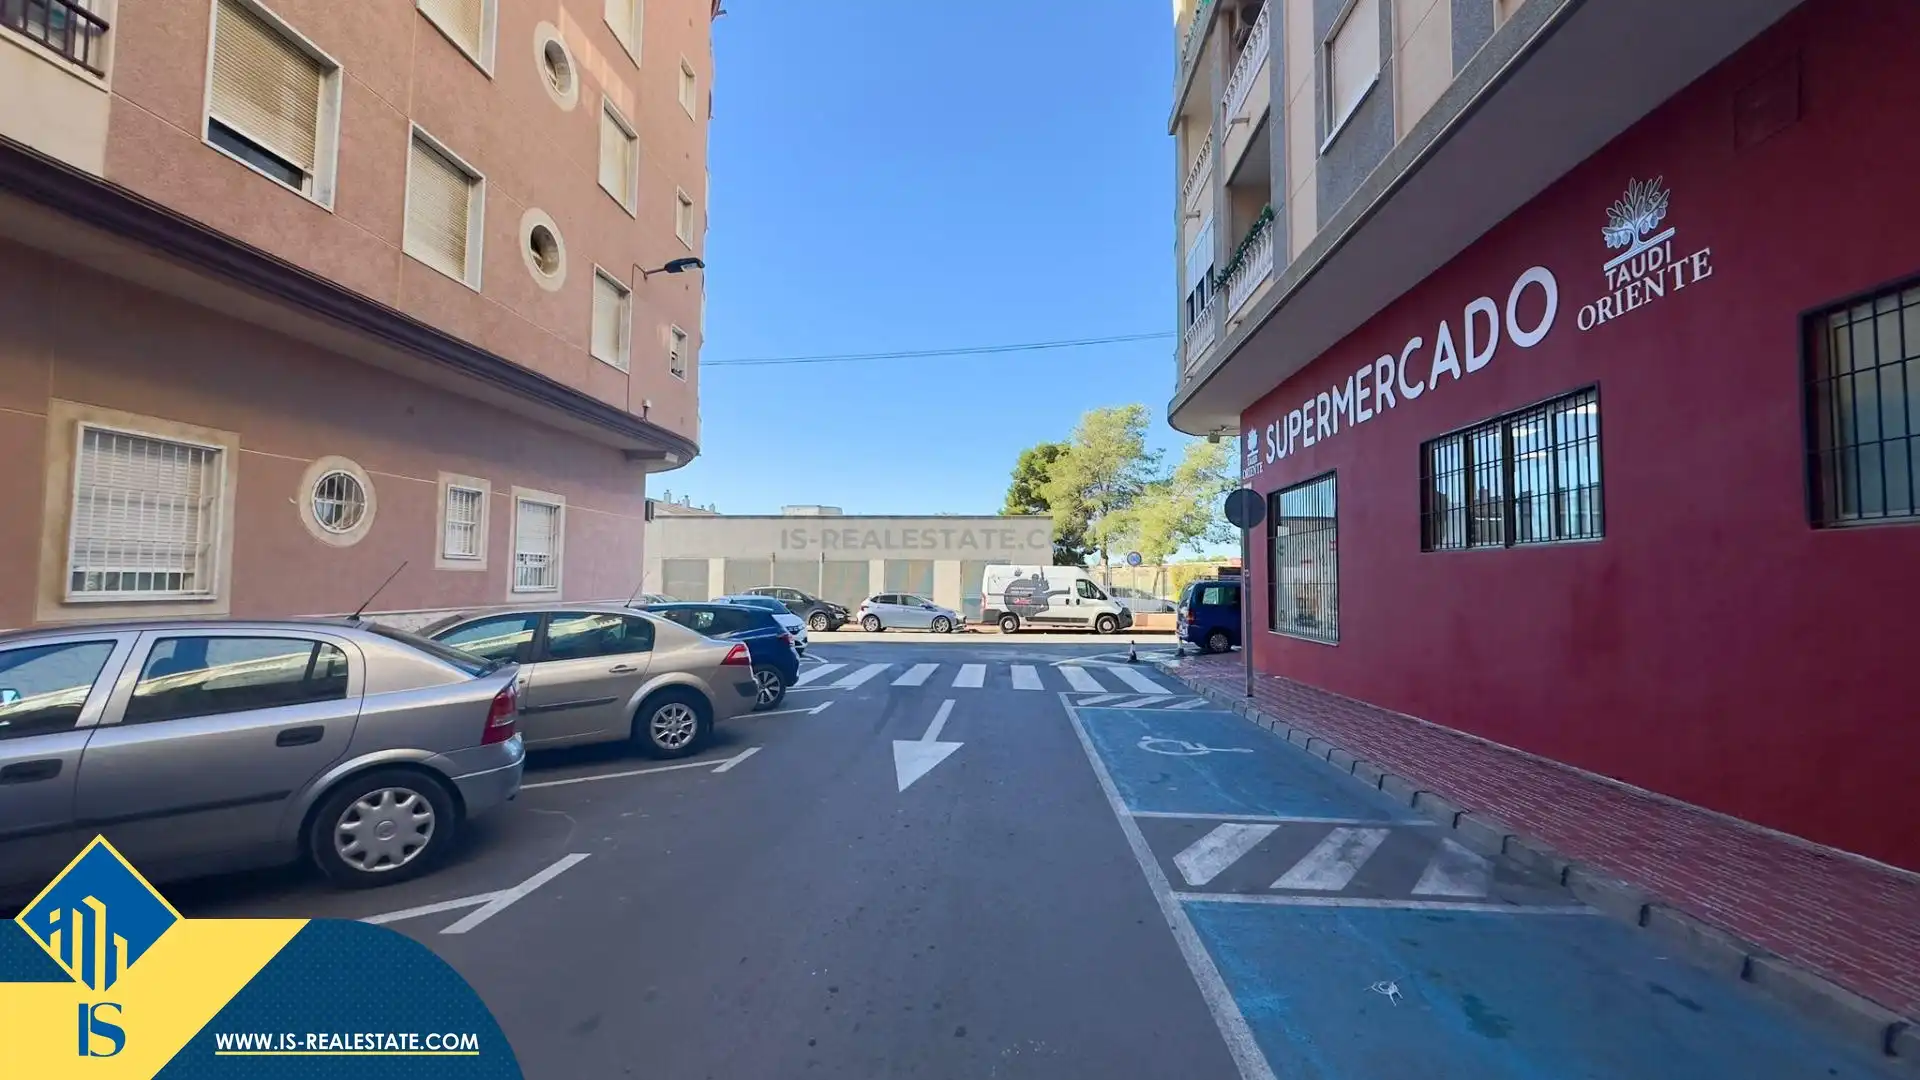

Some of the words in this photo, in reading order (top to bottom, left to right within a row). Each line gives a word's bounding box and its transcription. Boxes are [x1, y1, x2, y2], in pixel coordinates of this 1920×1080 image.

[1577, 247, 1713, 331] ORIENTE
[1605, 240, 1671, 291] TAUDI
[1266, 265, 1559, 465] SUPERMERCADO
